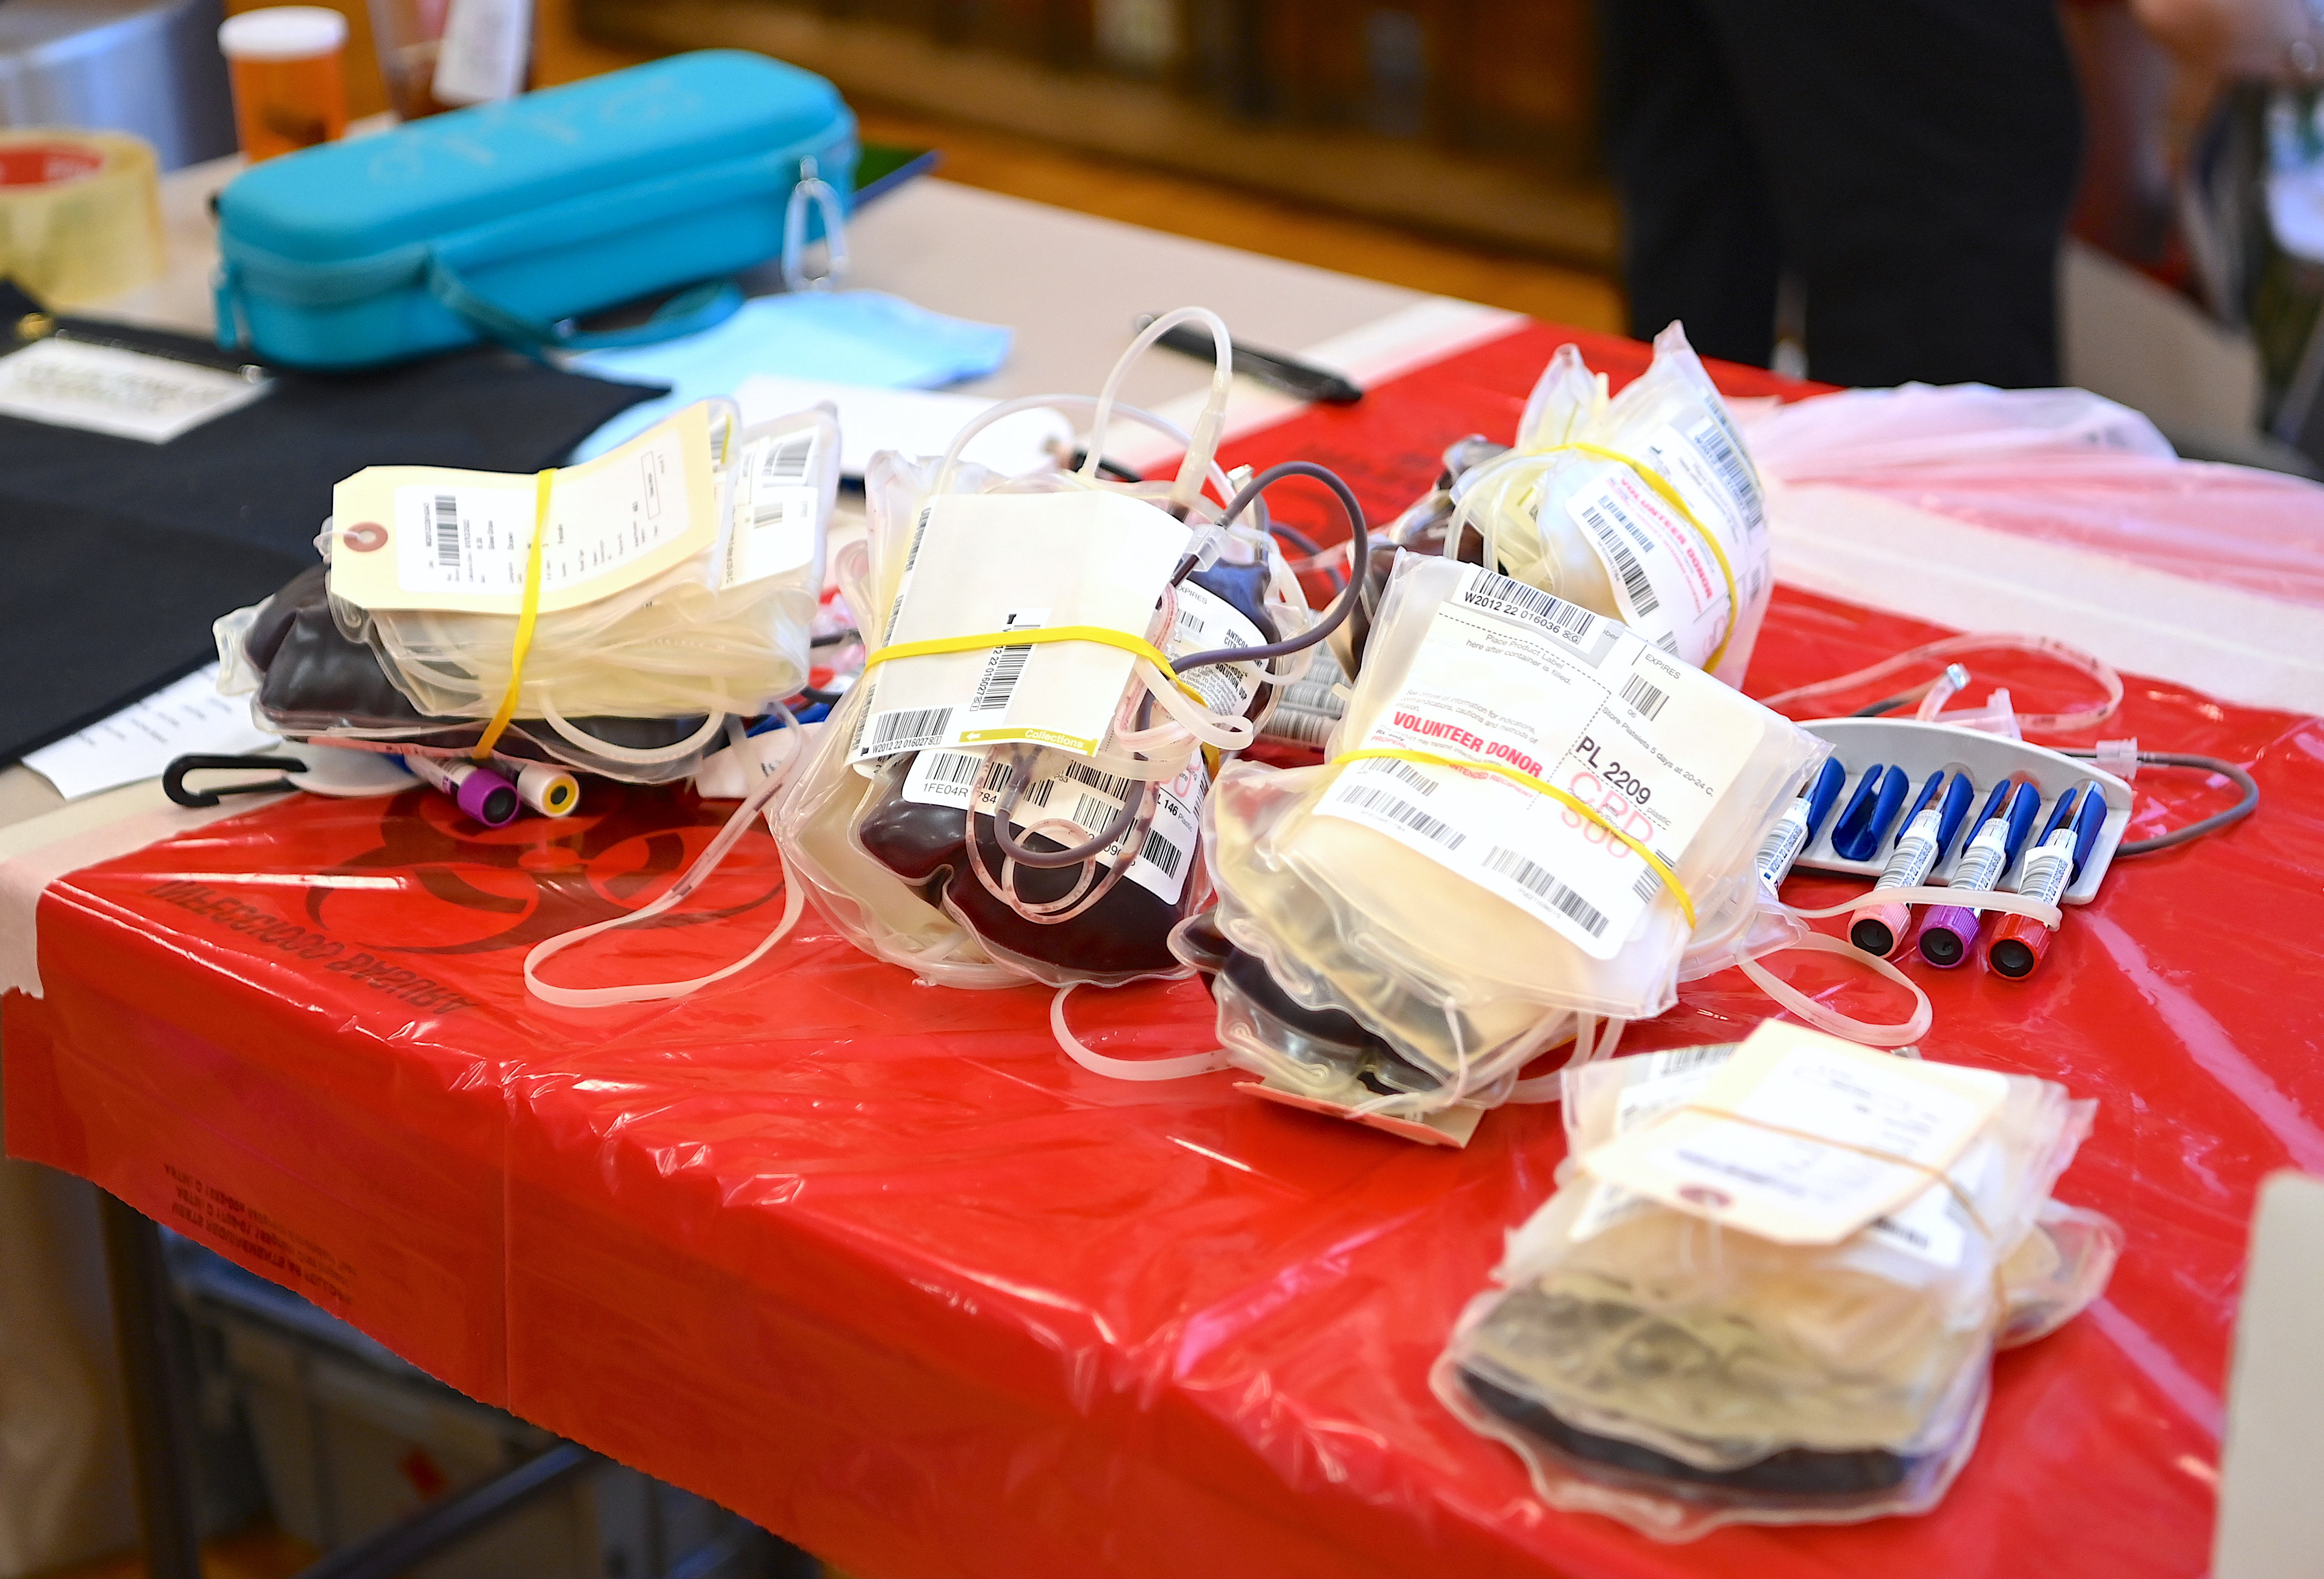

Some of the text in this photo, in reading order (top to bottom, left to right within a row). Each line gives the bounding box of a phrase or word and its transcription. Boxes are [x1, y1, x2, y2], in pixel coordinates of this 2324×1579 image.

[1687, 547, 1713, 600] DONOR
[1177, 584, 1207, 604] XPIRES
[1465, 591, 1502, 611] W2012
[1503, 604, 1519, 616] 22
[1521, 610, 1560, 634] 016036
[988, 657, 999, 666] 22
[1466, 640, 1483, 650] here
[1485, 645, 1503, 655] after
[1505, 650, 1542, 667] container
[1486, 634, 1564, 669] Place Product Label
[1645, 654, 1681, 680] EXPIRES
[1455, 707, 1484, 723] cautions
[1484, 719, 1499, 728] and
[1529, 735, 1539, 744] of
[1488, 710, 1499, 719] for
[873, 742, 893, 754] W2012
[894, 740, 902, 749] 22
[1024, 729, 1084, 749] Collections
[1393, 711, 1543, 778] VOLUNTEER DONOR
[1601, 706, 1621, 725] Store
[1621, 722, 1650, 749] Platelets
[1656, 751, 1674, 769] days
[1673, 765, 1683, 774] at
[1683, 771, 1706, 789] 20-24
[1575, 735, 1651, 805] PL 2209
[1489, 774, 1533, 798] RECIPIENT
[1164, 800, 1179, 816] 146
[1646, 807, 1672, 827] plastic
